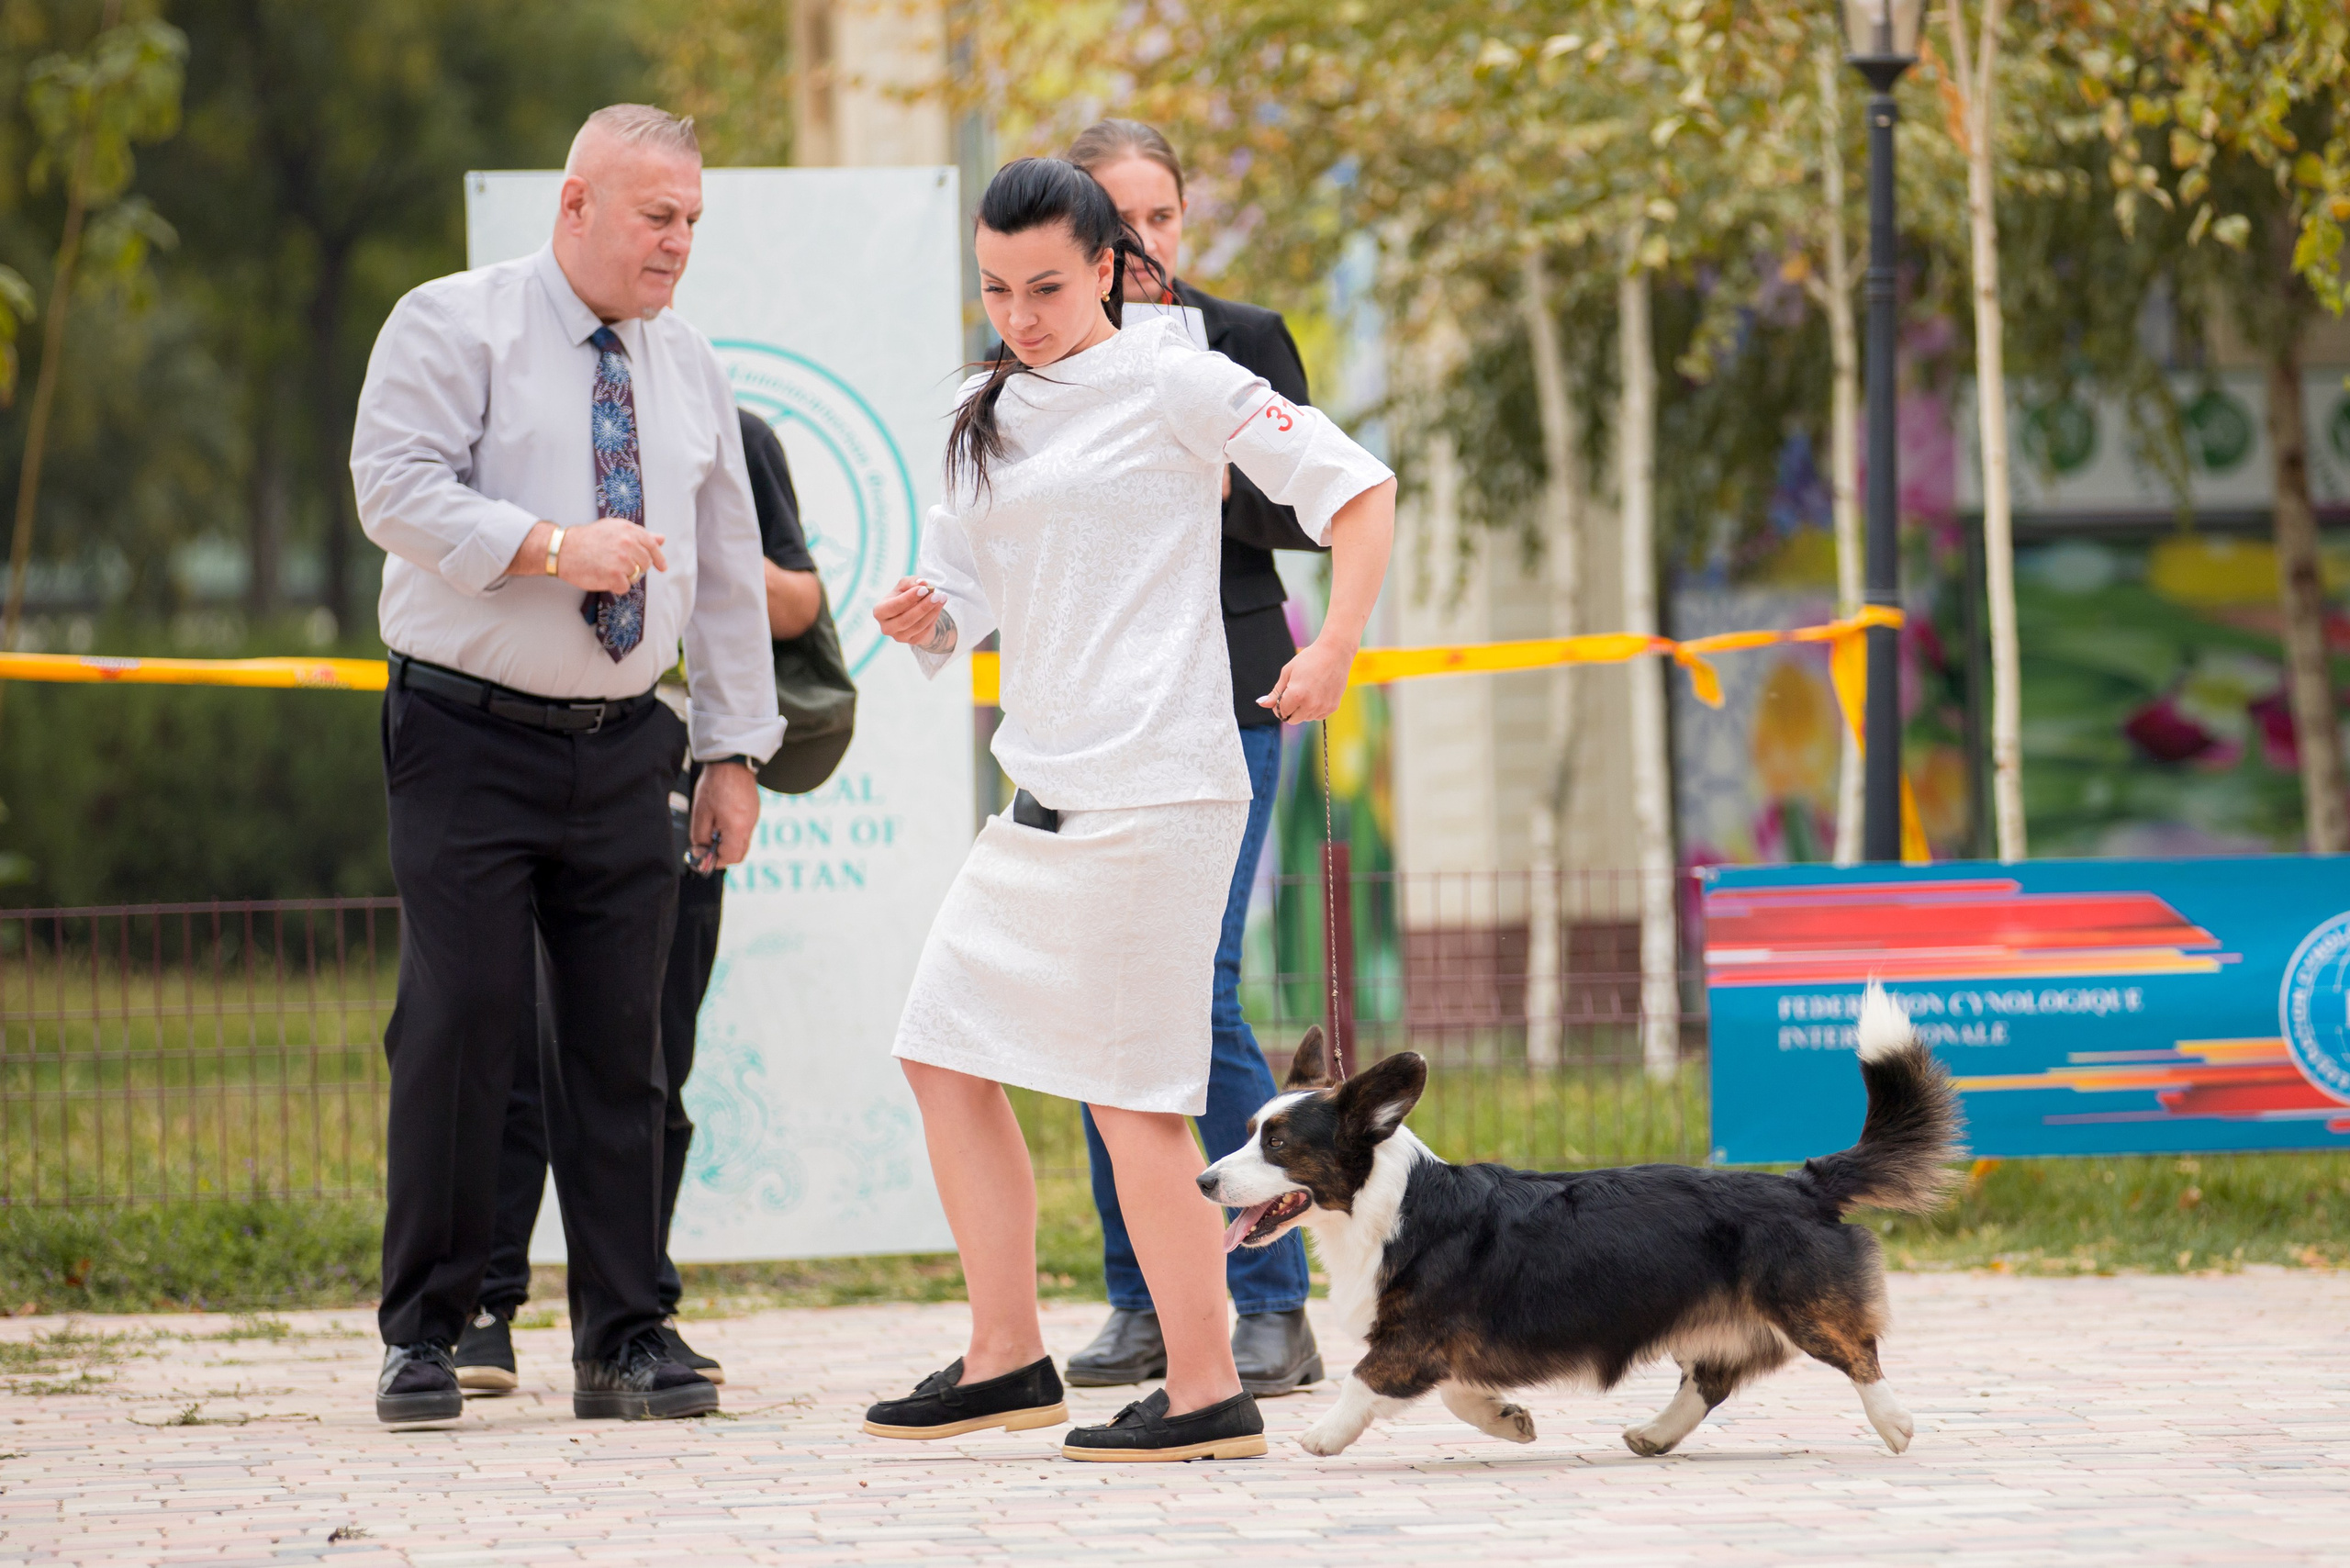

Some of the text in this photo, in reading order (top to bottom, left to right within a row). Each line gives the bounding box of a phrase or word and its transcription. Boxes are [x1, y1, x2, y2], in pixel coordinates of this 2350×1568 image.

[1265, 397, 1304, 432] 31
[757, 814, 905, 849] ION OF
